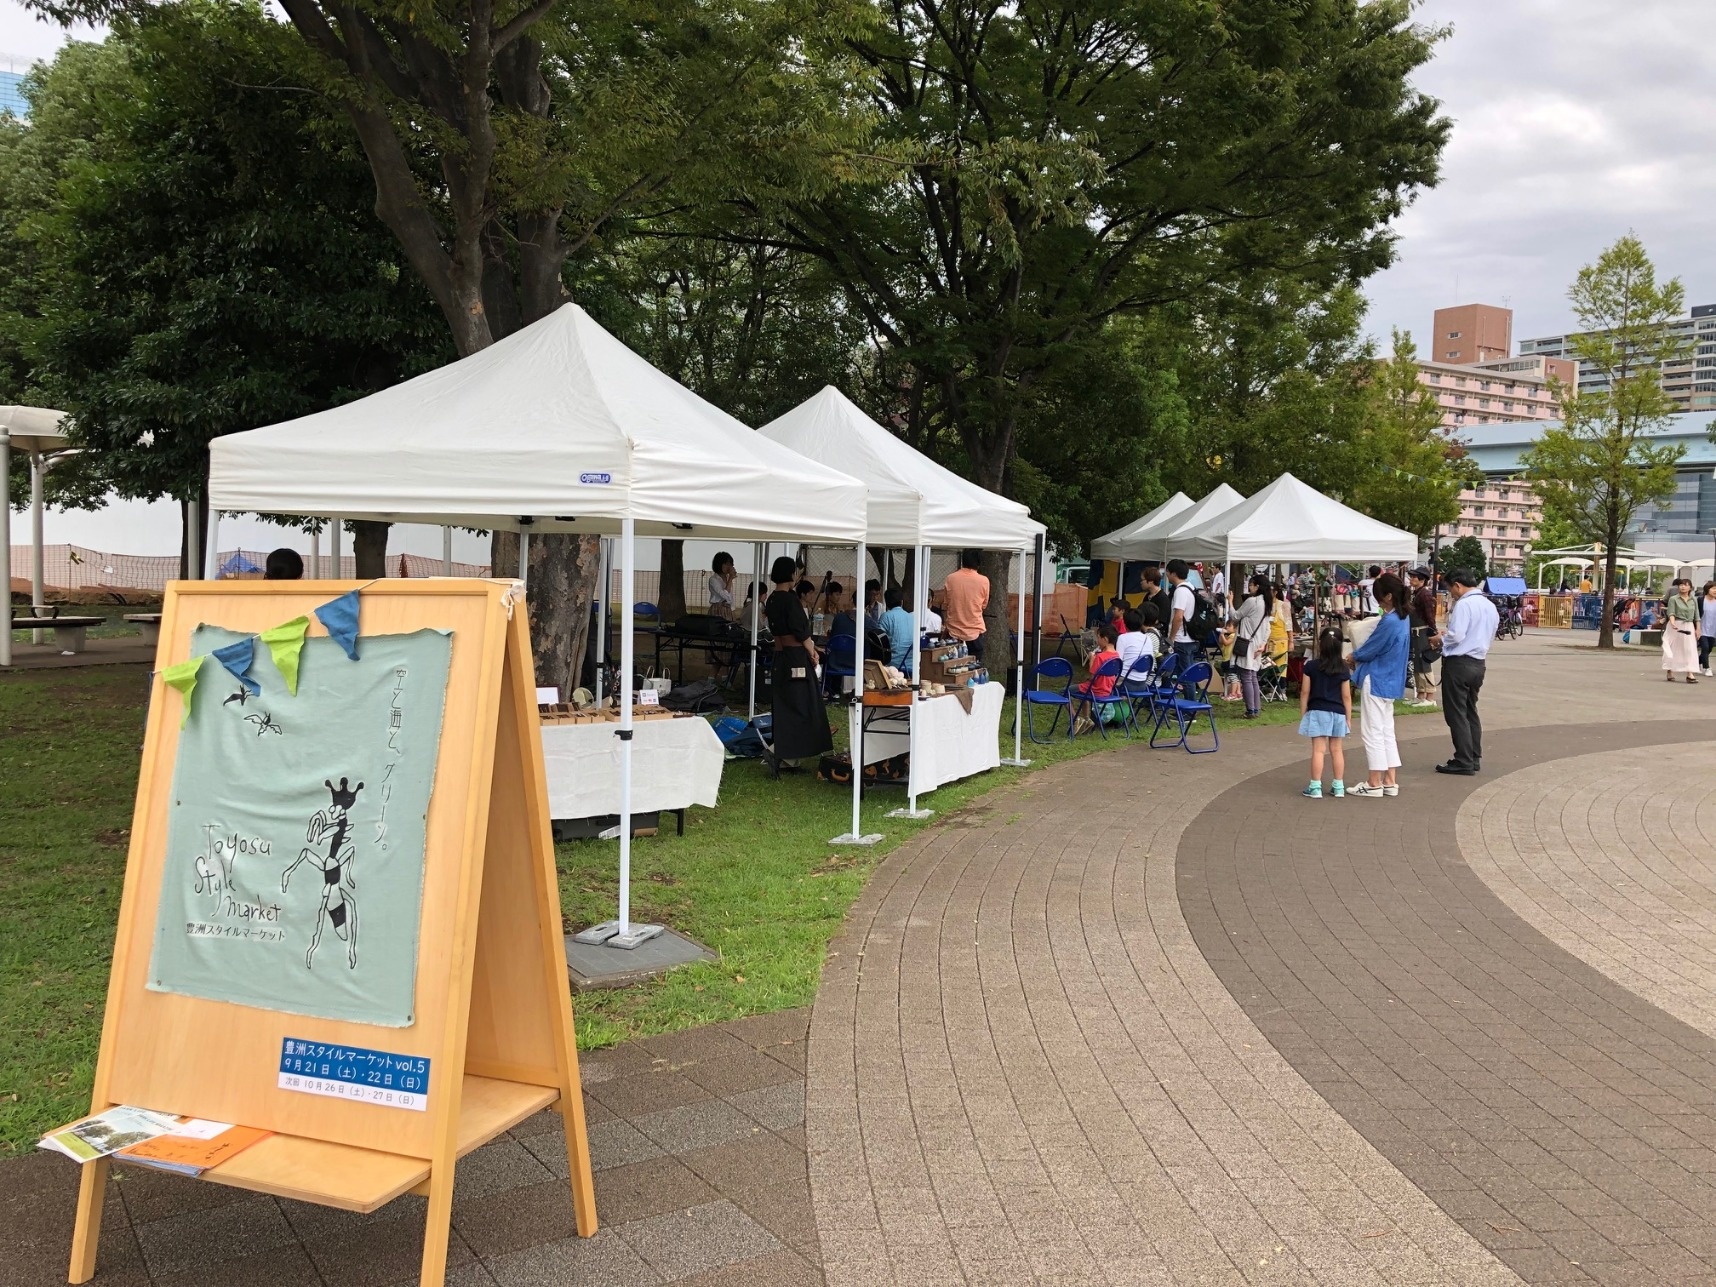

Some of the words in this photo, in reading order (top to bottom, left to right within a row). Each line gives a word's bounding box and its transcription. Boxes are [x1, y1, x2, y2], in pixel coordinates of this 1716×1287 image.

[201, 824, 271, 874] Toyosu
[194, 856, 237, 917] Style
[186, 922, 285, 941] 豊洲スタイルマーケット
[284, 1040, 393, 1069] 豊洲スタイルマーケット
[395, 1059, 426, 1074] vol.5
